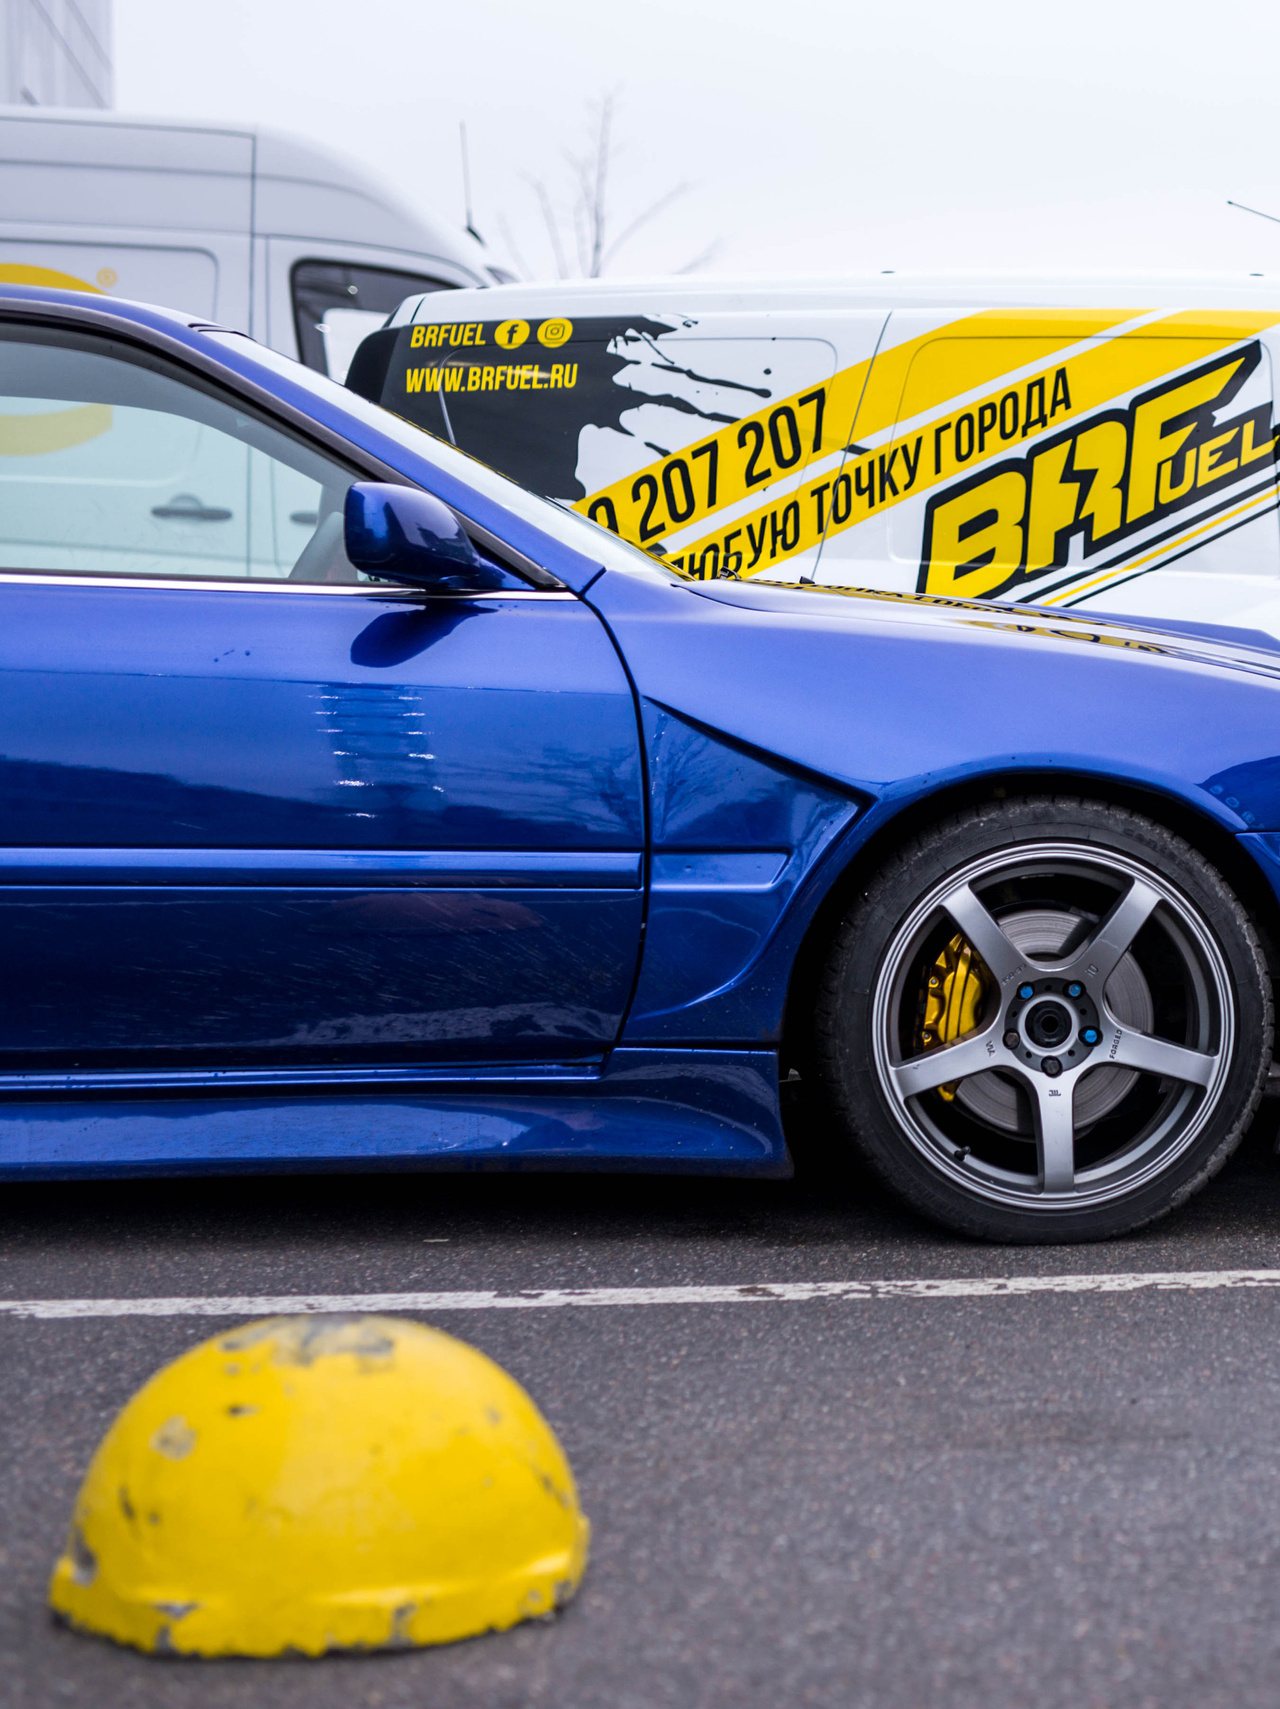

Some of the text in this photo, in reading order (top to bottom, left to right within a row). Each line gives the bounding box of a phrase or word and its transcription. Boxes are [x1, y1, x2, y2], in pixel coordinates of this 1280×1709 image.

[410, 323, 486, 348] BRFUEL
[406, 363, 578, 393] WWW.BRFUEL.RU
[631, 439, 719, 543] 207
[738, 387, 826, 488] 207
[810, 435, 923, 535] ТОЧКУ
[934, 366, 1072, 476] ГОРОДА
[1108, 1029, 1123, 1060] FORGED
